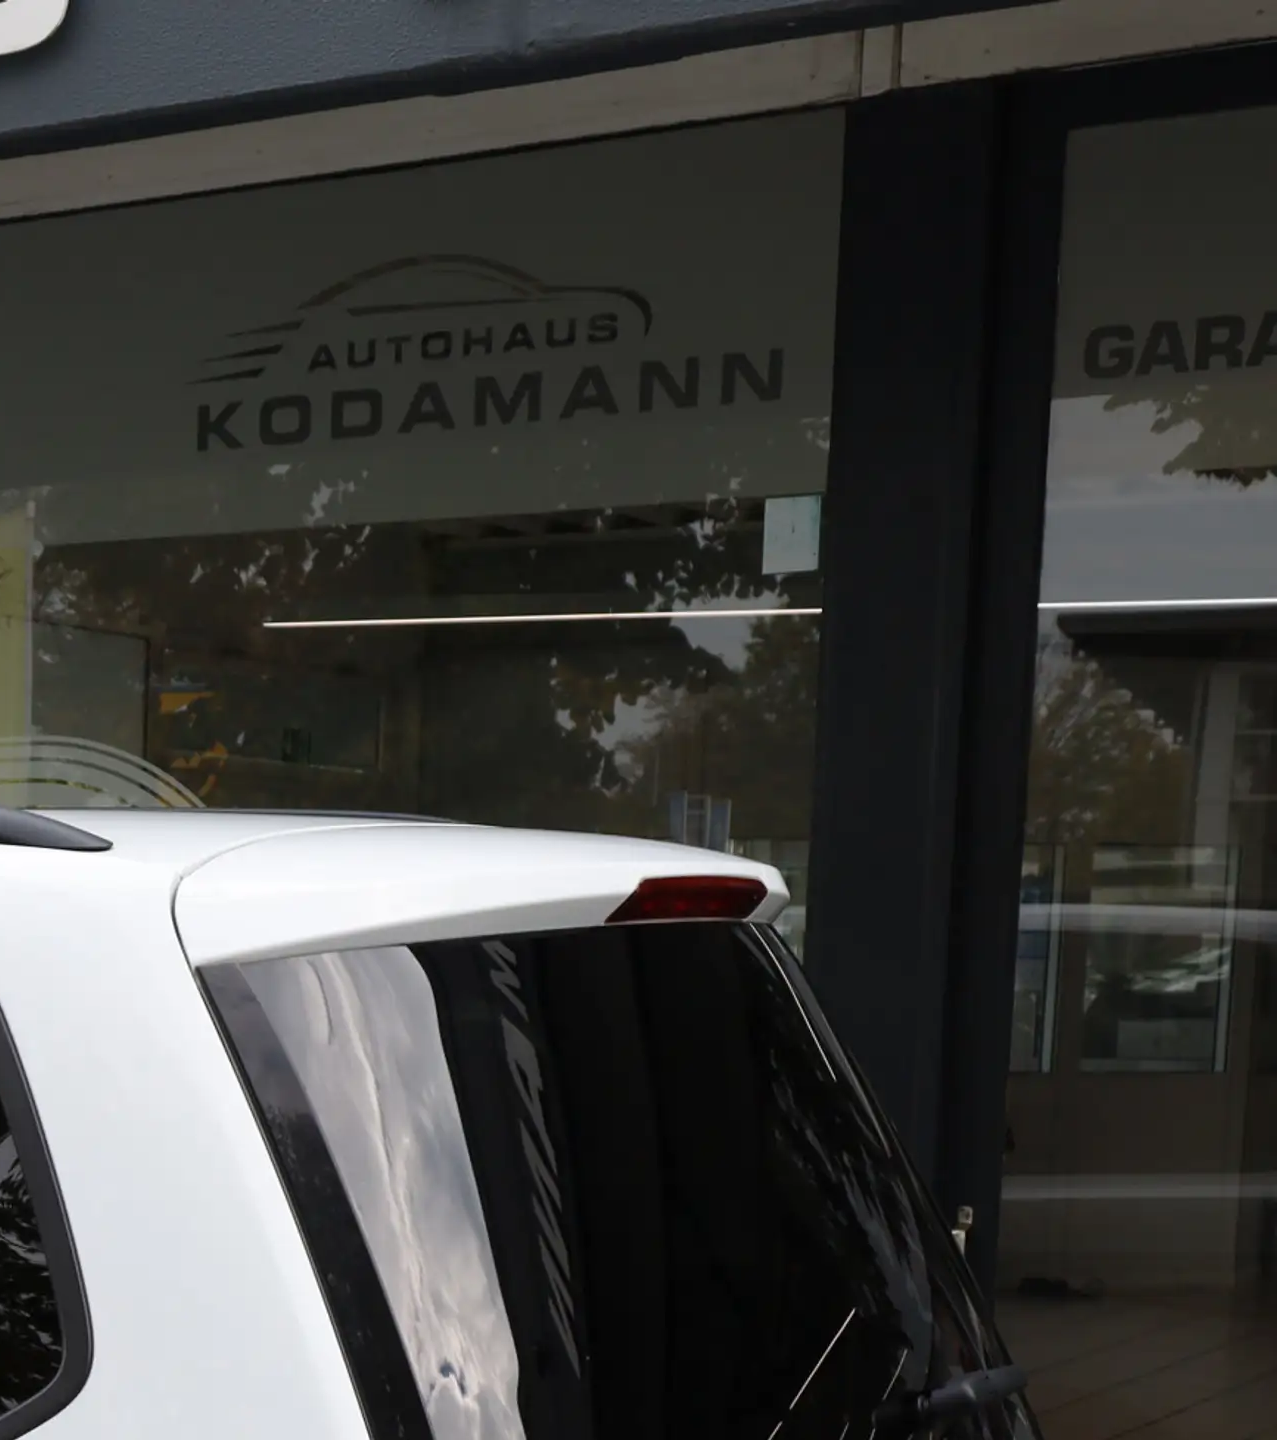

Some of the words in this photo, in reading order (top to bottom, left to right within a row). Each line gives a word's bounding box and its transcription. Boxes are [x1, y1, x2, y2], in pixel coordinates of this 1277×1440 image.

[307, 312, 619, 372] AUTOHAUS
[1083, 310, 1277, 379] GARA
[196, 348, 785, 452] KODAMANN
